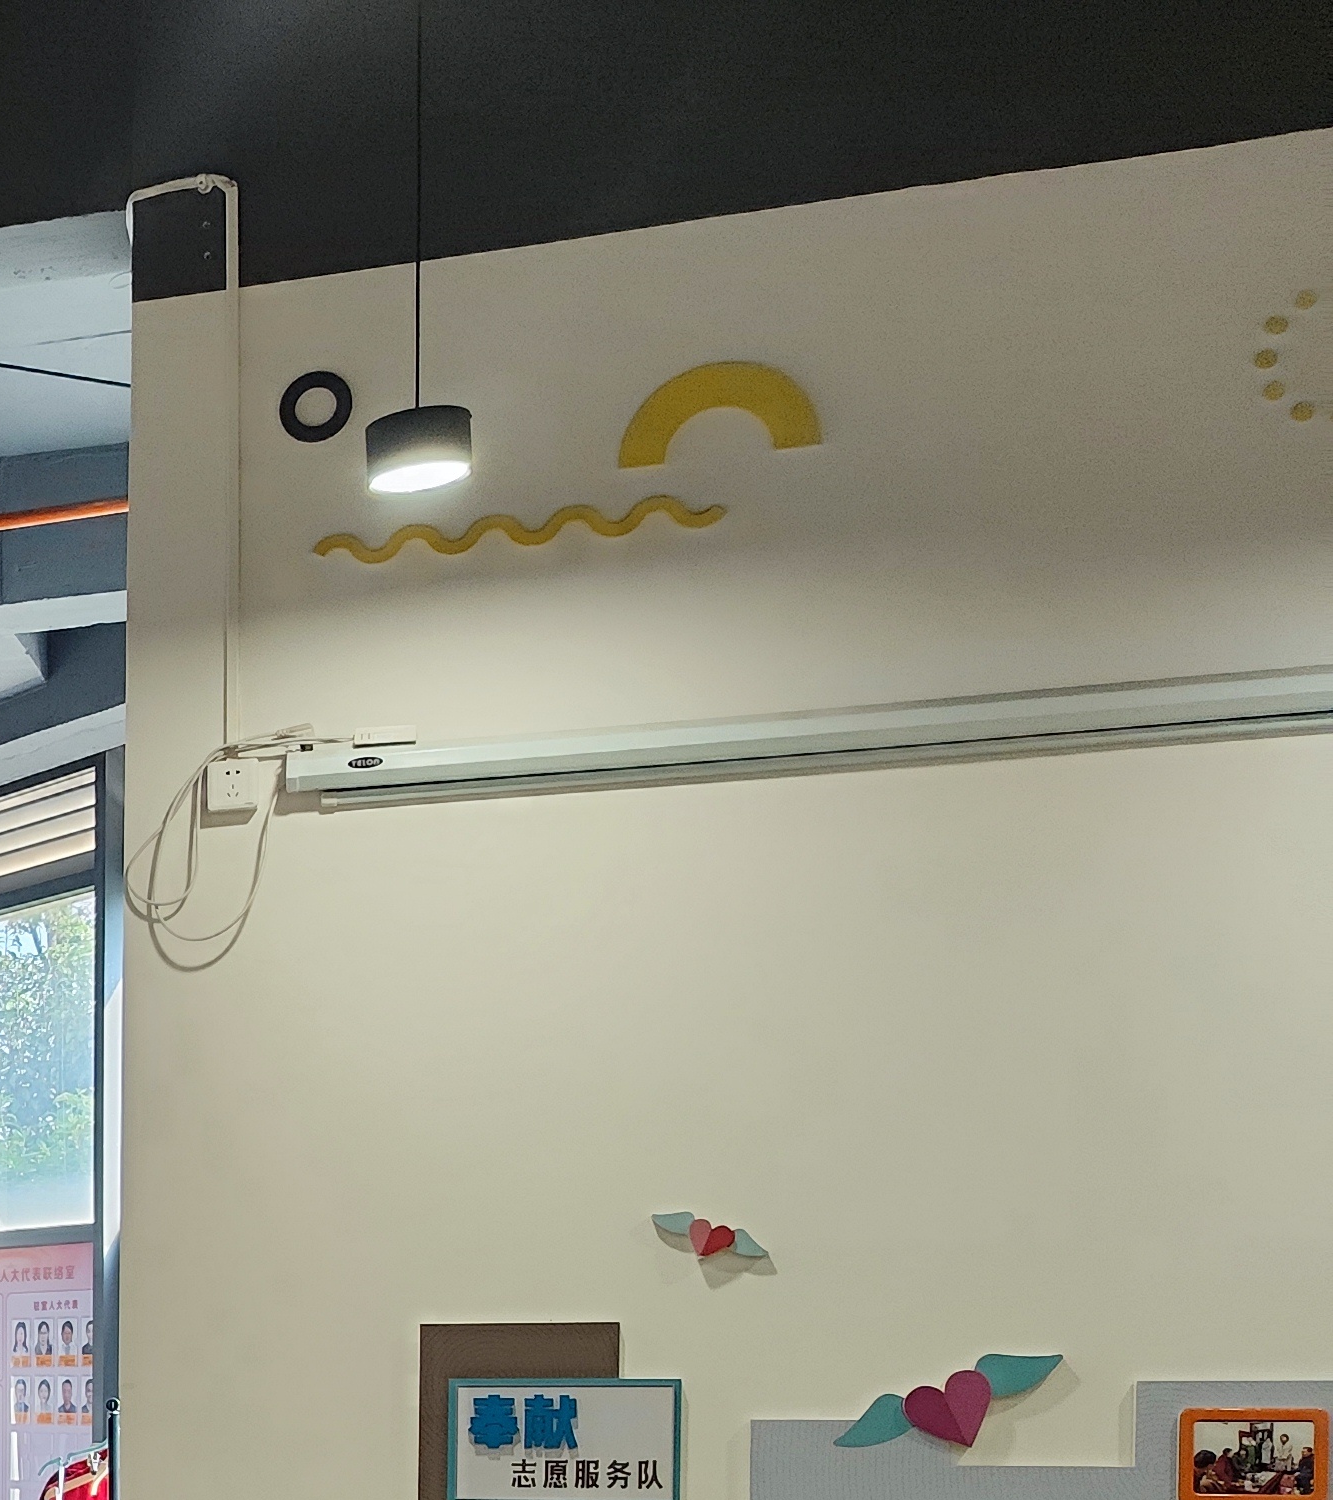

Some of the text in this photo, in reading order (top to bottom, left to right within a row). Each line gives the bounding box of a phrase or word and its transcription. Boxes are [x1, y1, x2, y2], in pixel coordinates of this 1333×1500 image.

[467, 1394, 579, 1453] 奉献
[511, 1459, 663, 1489] 志愿服务队
